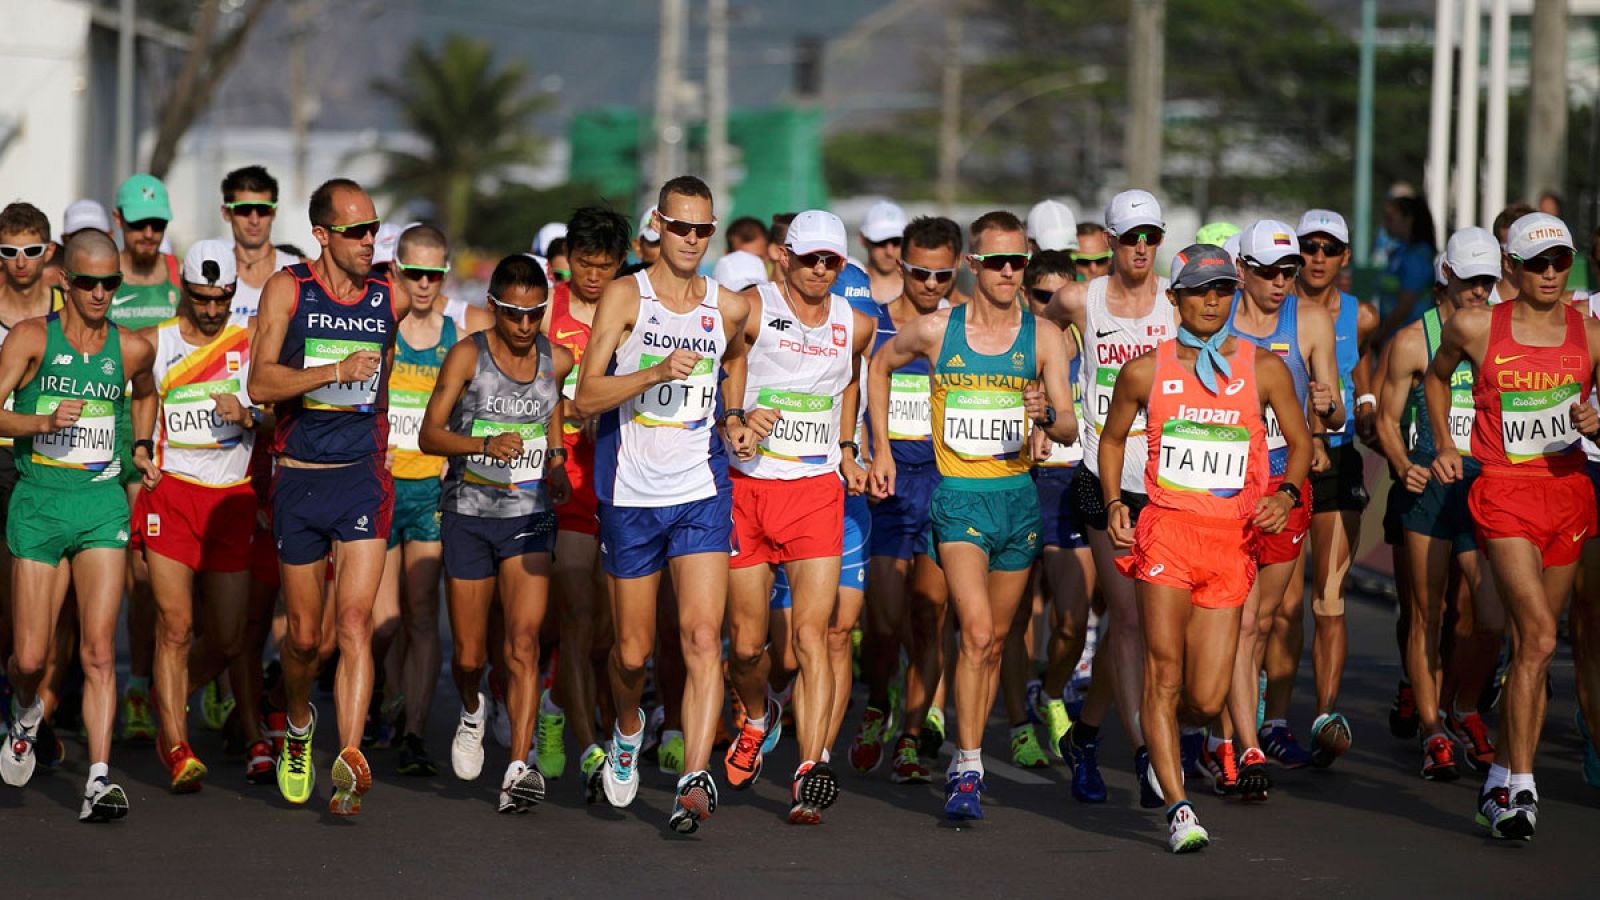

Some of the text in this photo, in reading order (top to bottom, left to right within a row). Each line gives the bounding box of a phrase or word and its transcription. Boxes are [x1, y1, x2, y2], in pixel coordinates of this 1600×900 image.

[1528, 228, 1564, 240] CHINA
[308, 313, 386, 333] FRANCE
[768, 318, 792, 331] 4F
[316, 344, 348, 355] Rio2016
[643, 331, 717, 354] SLOVAKIA
[779, 340, 838, 357] POLSKA
[41, 376, 120, 400] IRELAND
[940, 373, 1028, 390] AUSTRALI
[1497, 370, 1575, 390] CHINA
[486, 395, 540, 416] ECUADOR
[771, 394, 802, 407] Rio2016
[958, 394, 992, 405] Rio2016
[1512, 396, 1547, 407] Rio2016
[168, 408, 233, 432] GARC
[888, 399, 931, 421] APAMIC
[1169, 404, 1241, 425] Japan
[768, 417, 830, 444] GUSTYN
[946, 416, 1023, 441] TALLENT
[1175, 424, 1210, 436] Rio2016
[1162, 445, 1245, 478] TANII
